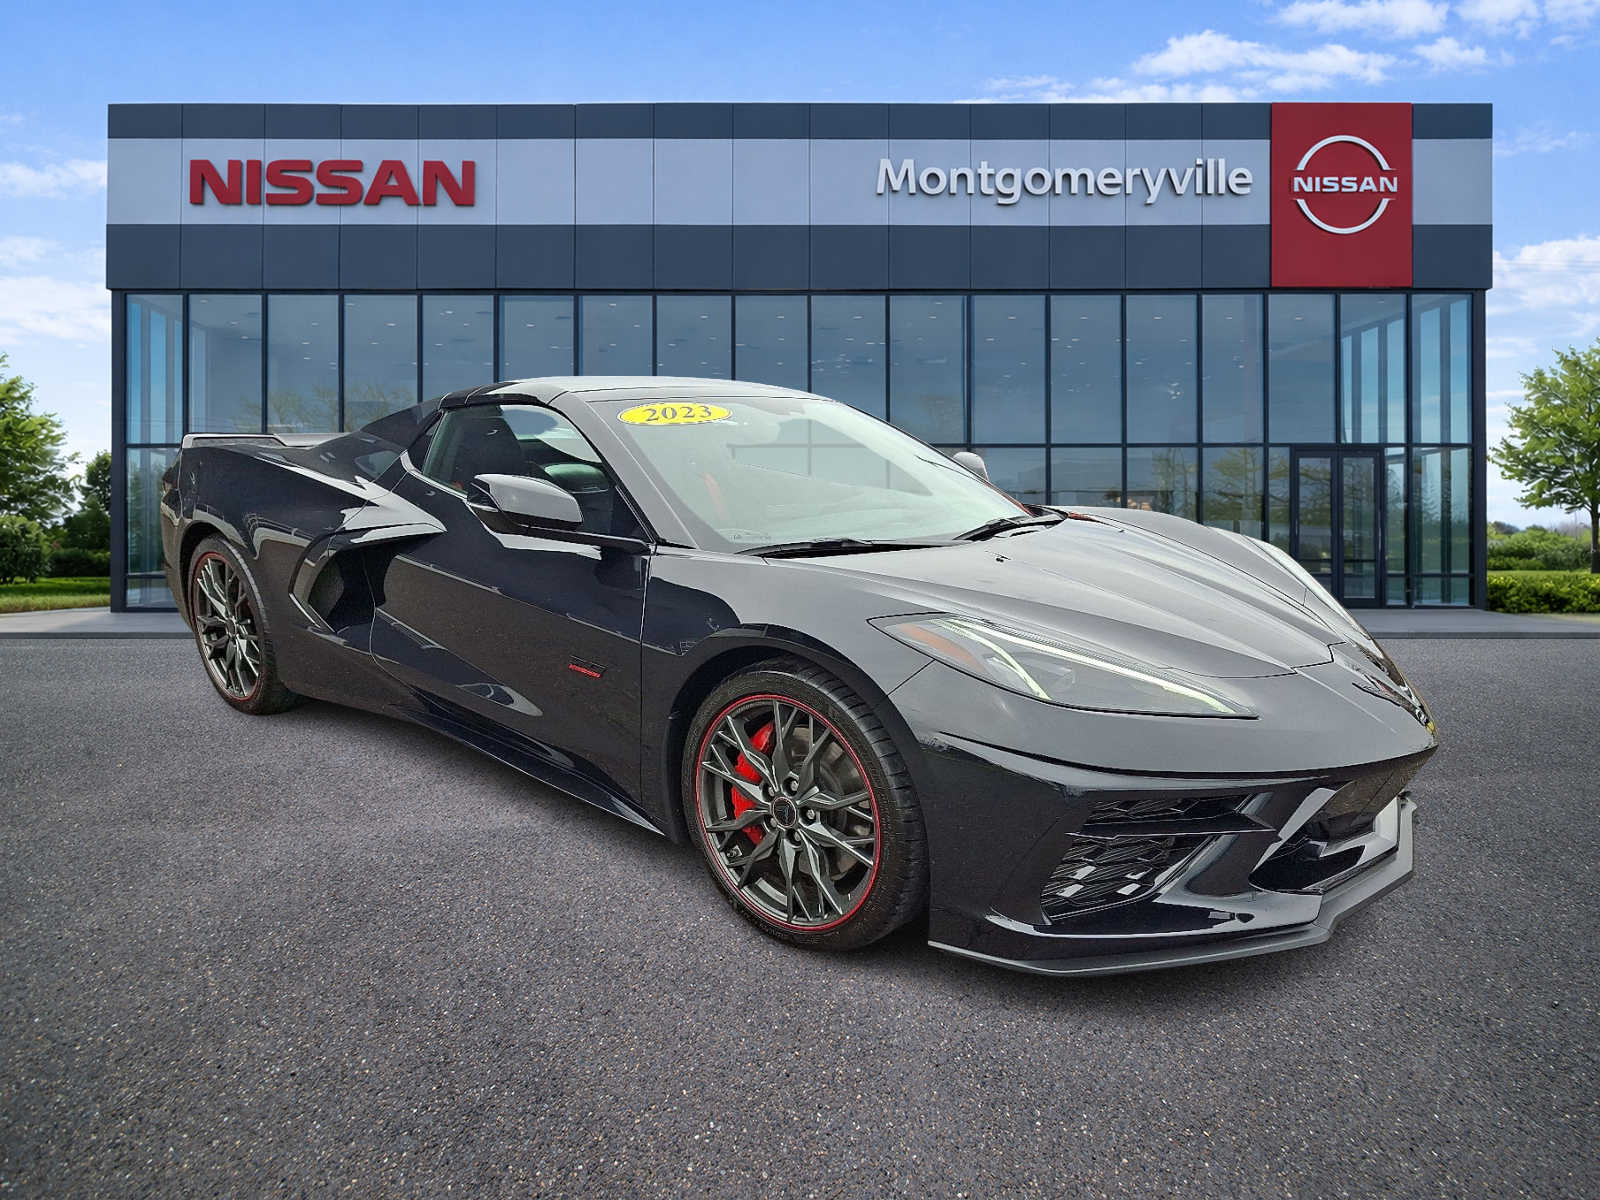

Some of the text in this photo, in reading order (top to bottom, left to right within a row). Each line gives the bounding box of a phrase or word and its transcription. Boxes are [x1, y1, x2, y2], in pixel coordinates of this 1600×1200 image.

[190, 159, 476, 206] NISSAN
[876, 158, 1253, 205] Montgomeryville
[1293, 176, 1398, 192] NISSAN
[642, 405, 712, 422] 2023
